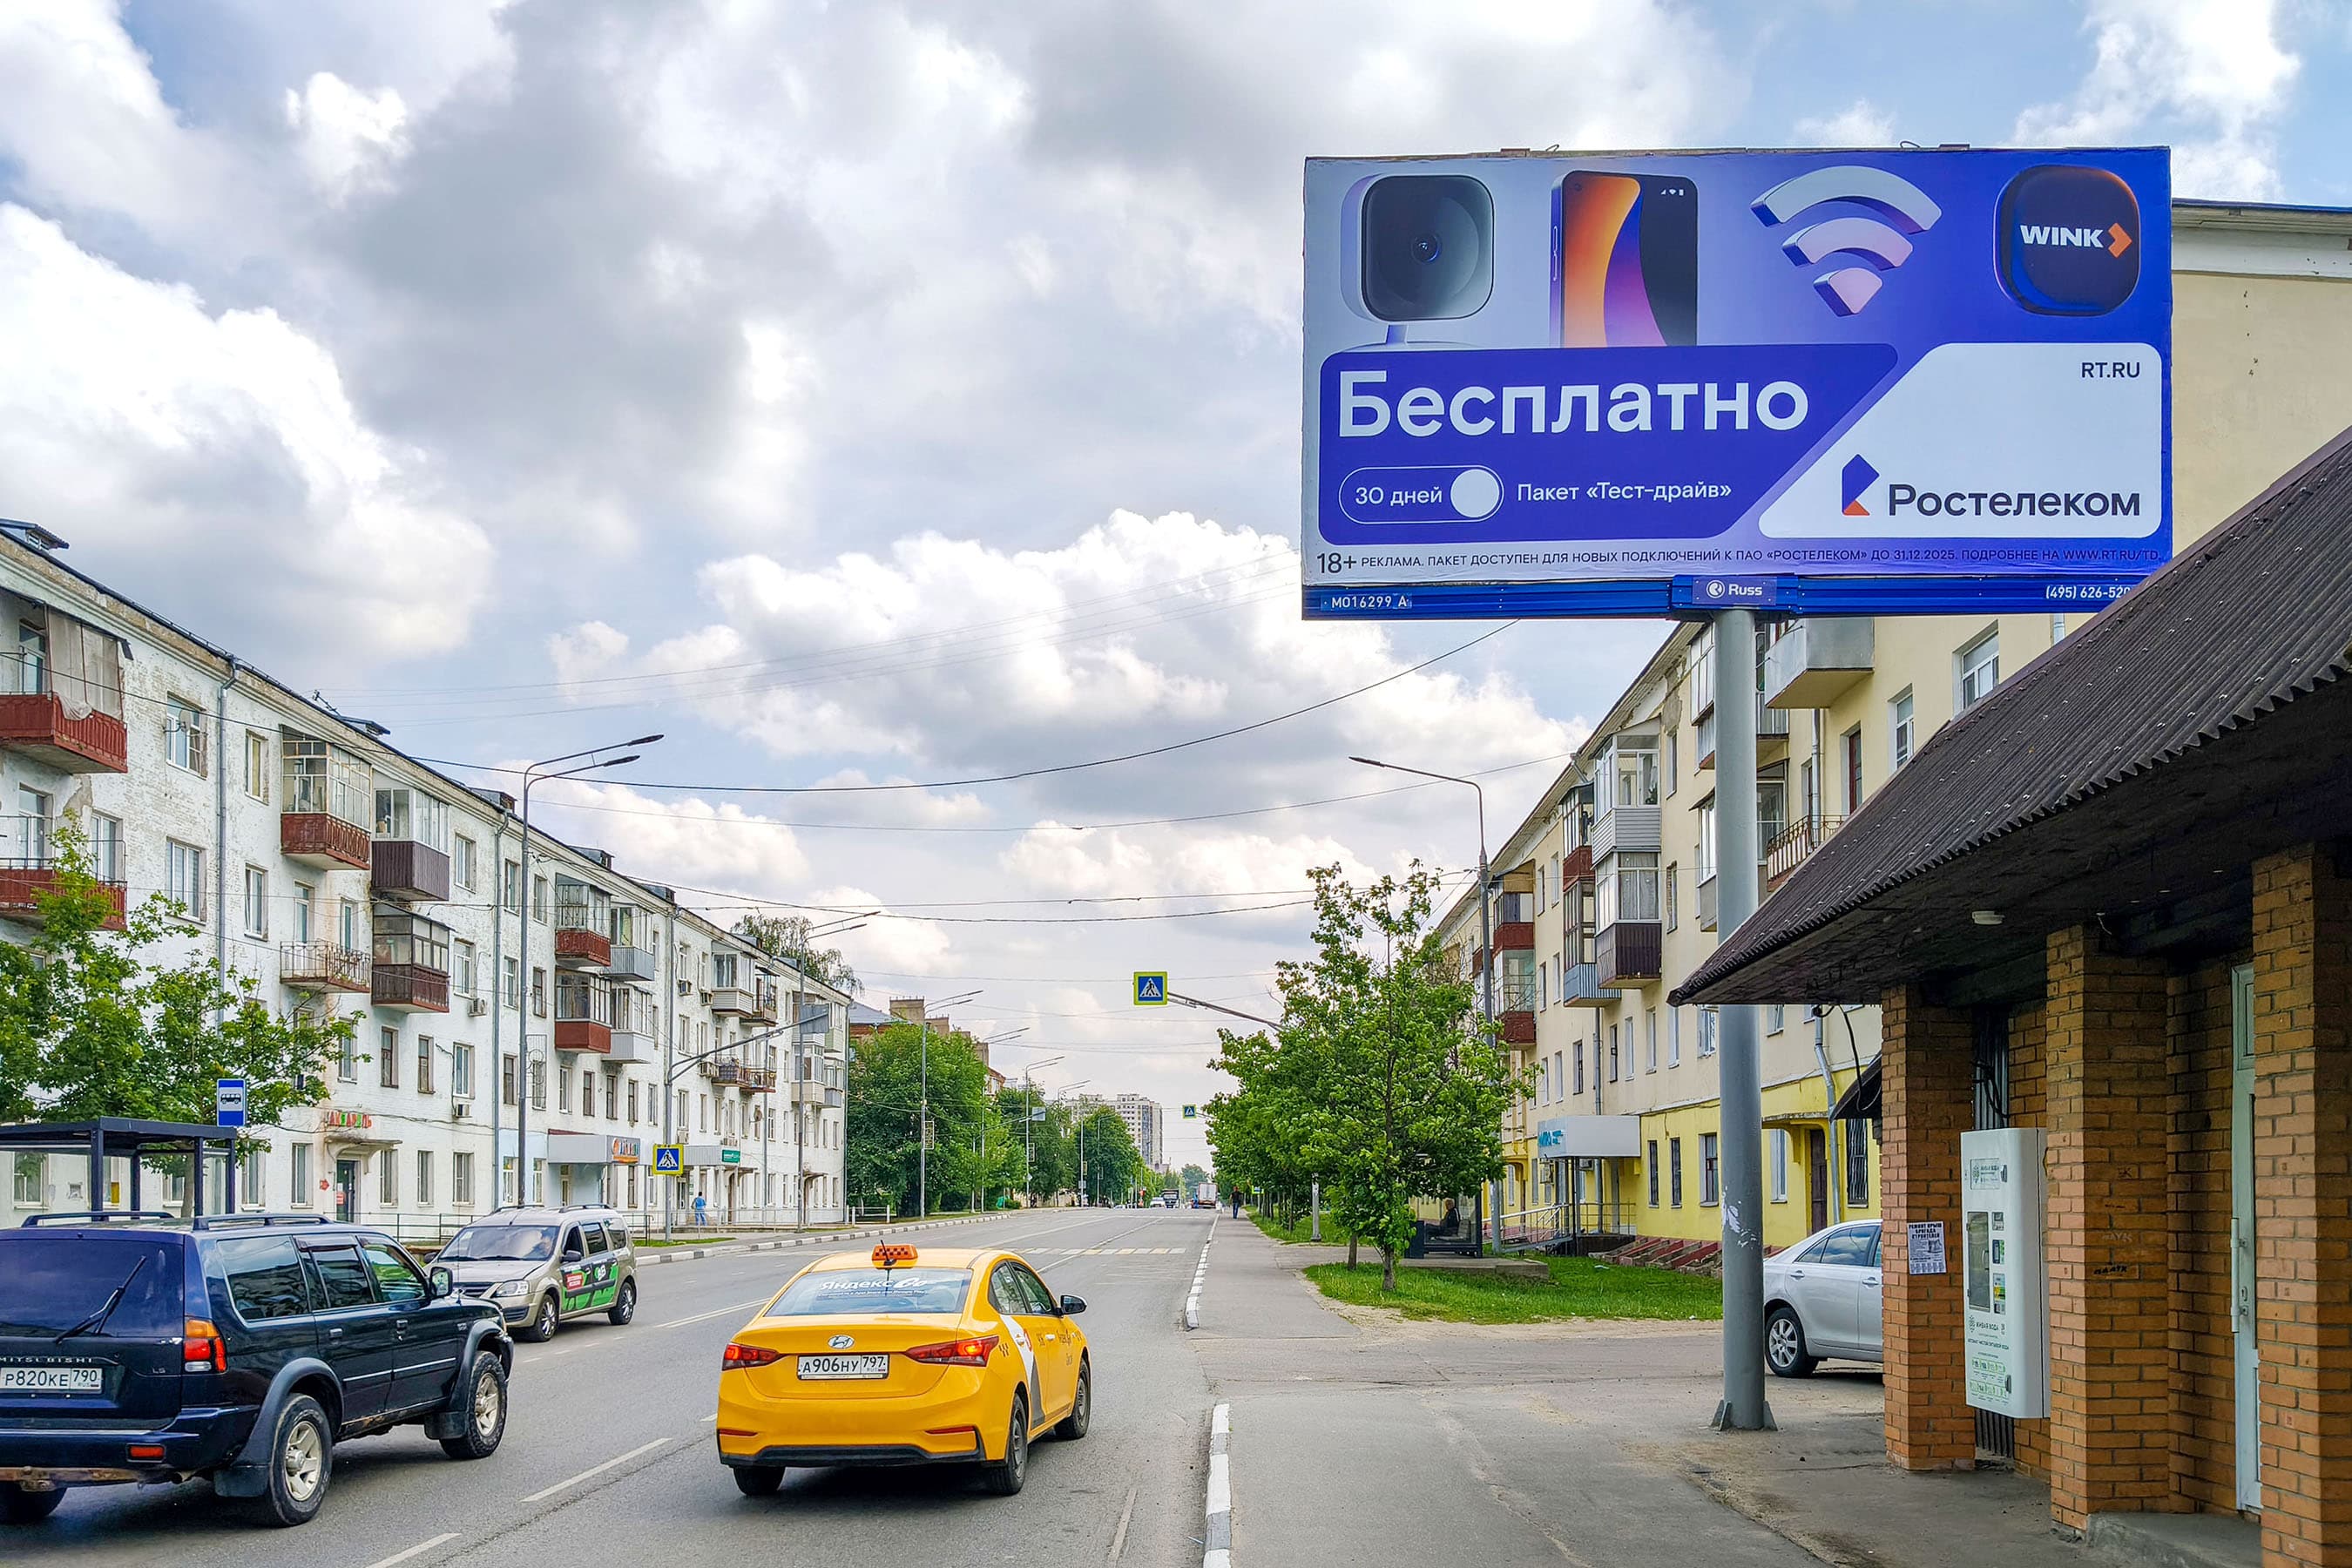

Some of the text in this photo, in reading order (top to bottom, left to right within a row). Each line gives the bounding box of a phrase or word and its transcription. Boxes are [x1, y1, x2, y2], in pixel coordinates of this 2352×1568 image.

[2019, 225, 2104, 248] WINK
[2081, 362, 2141, 379] RT.RU
[1338, 369, 1809, 437] Бесплатно
[1355, 485, 1443, 506] 30 дней
[1517, 481, 1733, 503] Пакет «Тест-драйв»
[1889, 483, 2141, 517] Ростелеком
[1316, 552, 1357, 574] 18+
[1361, 556, 1424, 567] РЕКЛАМА.
[1428, 555, 1467, 566] ПАКЕТ
[1470, 553, 1538, 566] ДОСТУПЕН
[1542, 552, 1569, 565] ДЛЯ
[1571, 551, 1618, 563] НОВЫХ
[1621, 548, 1721, 563] ПОДКЛЮЧЕНИЙ
[1724, 550, 1733, 561] К
[1736, 550, 1763, 561] ПАО
[1766, 549, 1868, 561] «РОСТЕЛЕКОМ»
[1870, 549, 1890, 561] ДО
[1893, 549, 1958, 560] 31.12.2025.
[1961, 549, 2038, 561] ПОДРОБНЕЕ
[2041, 550, 2060, 561] НА
[1728, 583, 1763, 597] Russ
[2045, 585, 2077, 599] (495)
[820, 1279, 895, 1290] Яндекс
[862, 1356, 885, 1368] 797
[72, 1369, 98, 1382] 790
